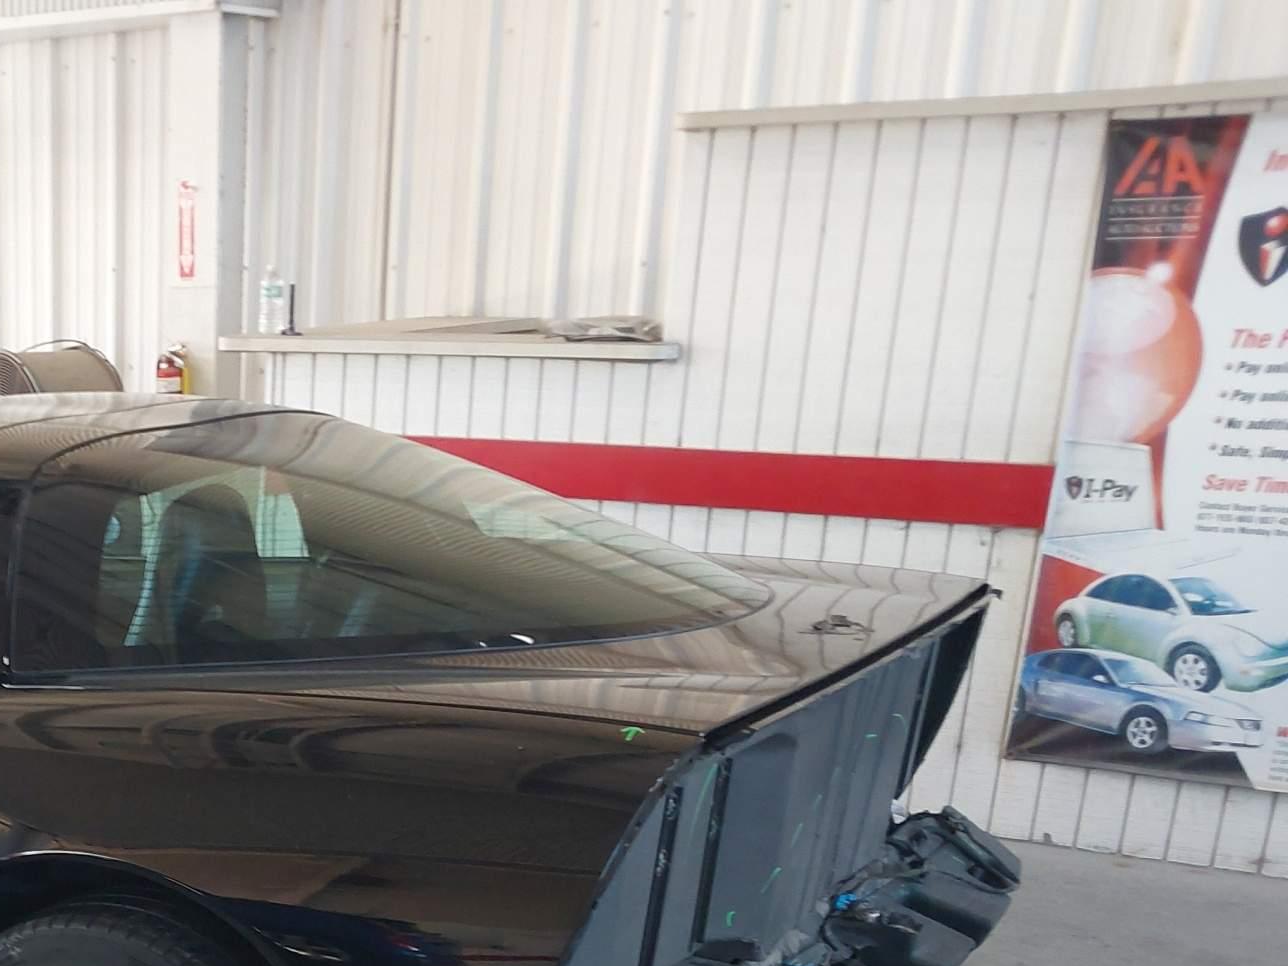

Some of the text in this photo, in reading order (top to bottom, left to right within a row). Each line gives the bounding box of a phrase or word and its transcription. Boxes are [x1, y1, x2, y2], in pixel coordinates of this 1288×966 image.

[1231, 328, 1273, 349] The
[1084, 478, 1138, 501] I-Pay
[1202, 474, 1248, 491] Save
